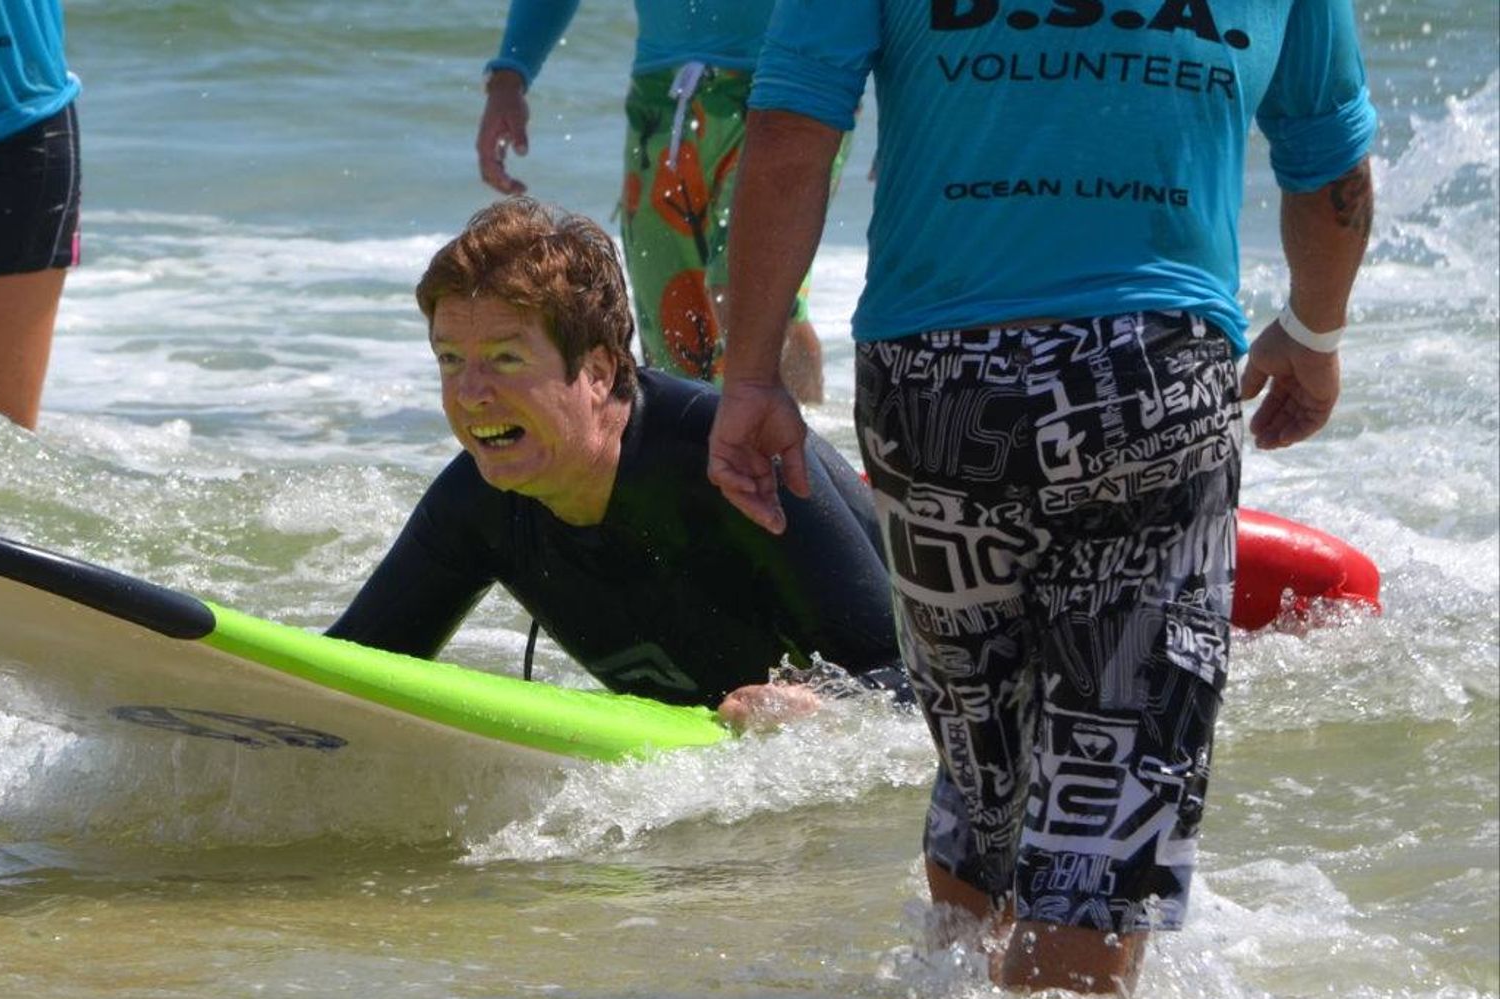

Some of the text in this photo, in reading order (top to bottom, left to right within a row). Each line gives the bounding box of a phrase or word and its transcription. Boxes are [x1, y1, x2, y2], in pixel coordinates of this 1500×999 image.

[937, 52, 1236, 99] VOLUNTEER
[944, 177, 1190, 207] OCEAN LIVING
